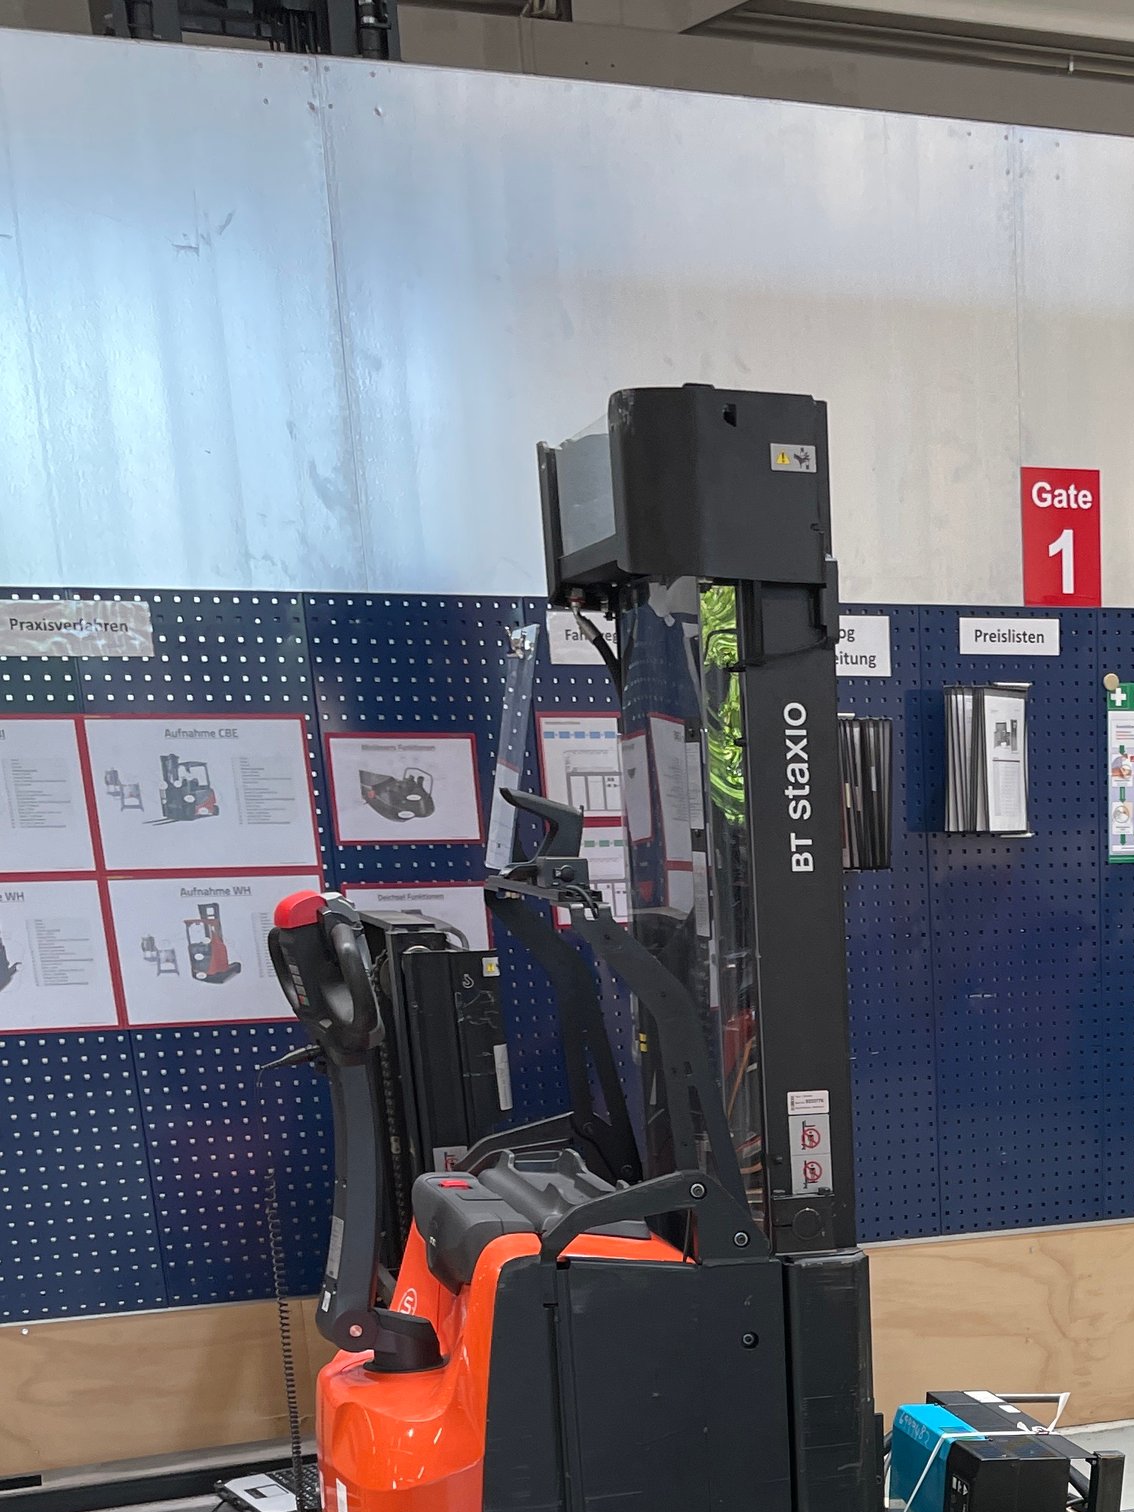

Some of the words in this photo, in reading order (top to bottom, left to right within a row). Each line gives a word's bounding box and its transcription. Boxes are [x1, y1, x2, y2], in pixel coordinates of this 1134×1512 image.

[1031, 481, 1093, 509] Gate
[1048, 528, 1075, 594] 1
[9, 618, 129, 632] Praxisverfahren
[974, 629, 1045, 643] Preislisten
[165, 728, 216, 738] Aufnahme
[218, 728, 239, 738] CBE
[790, 832, 814, 872] BT
[4, 891, 24, 902] WH
[180, 886, 231, 897] Aufnahme
[232, 885, 252, 895] WH
